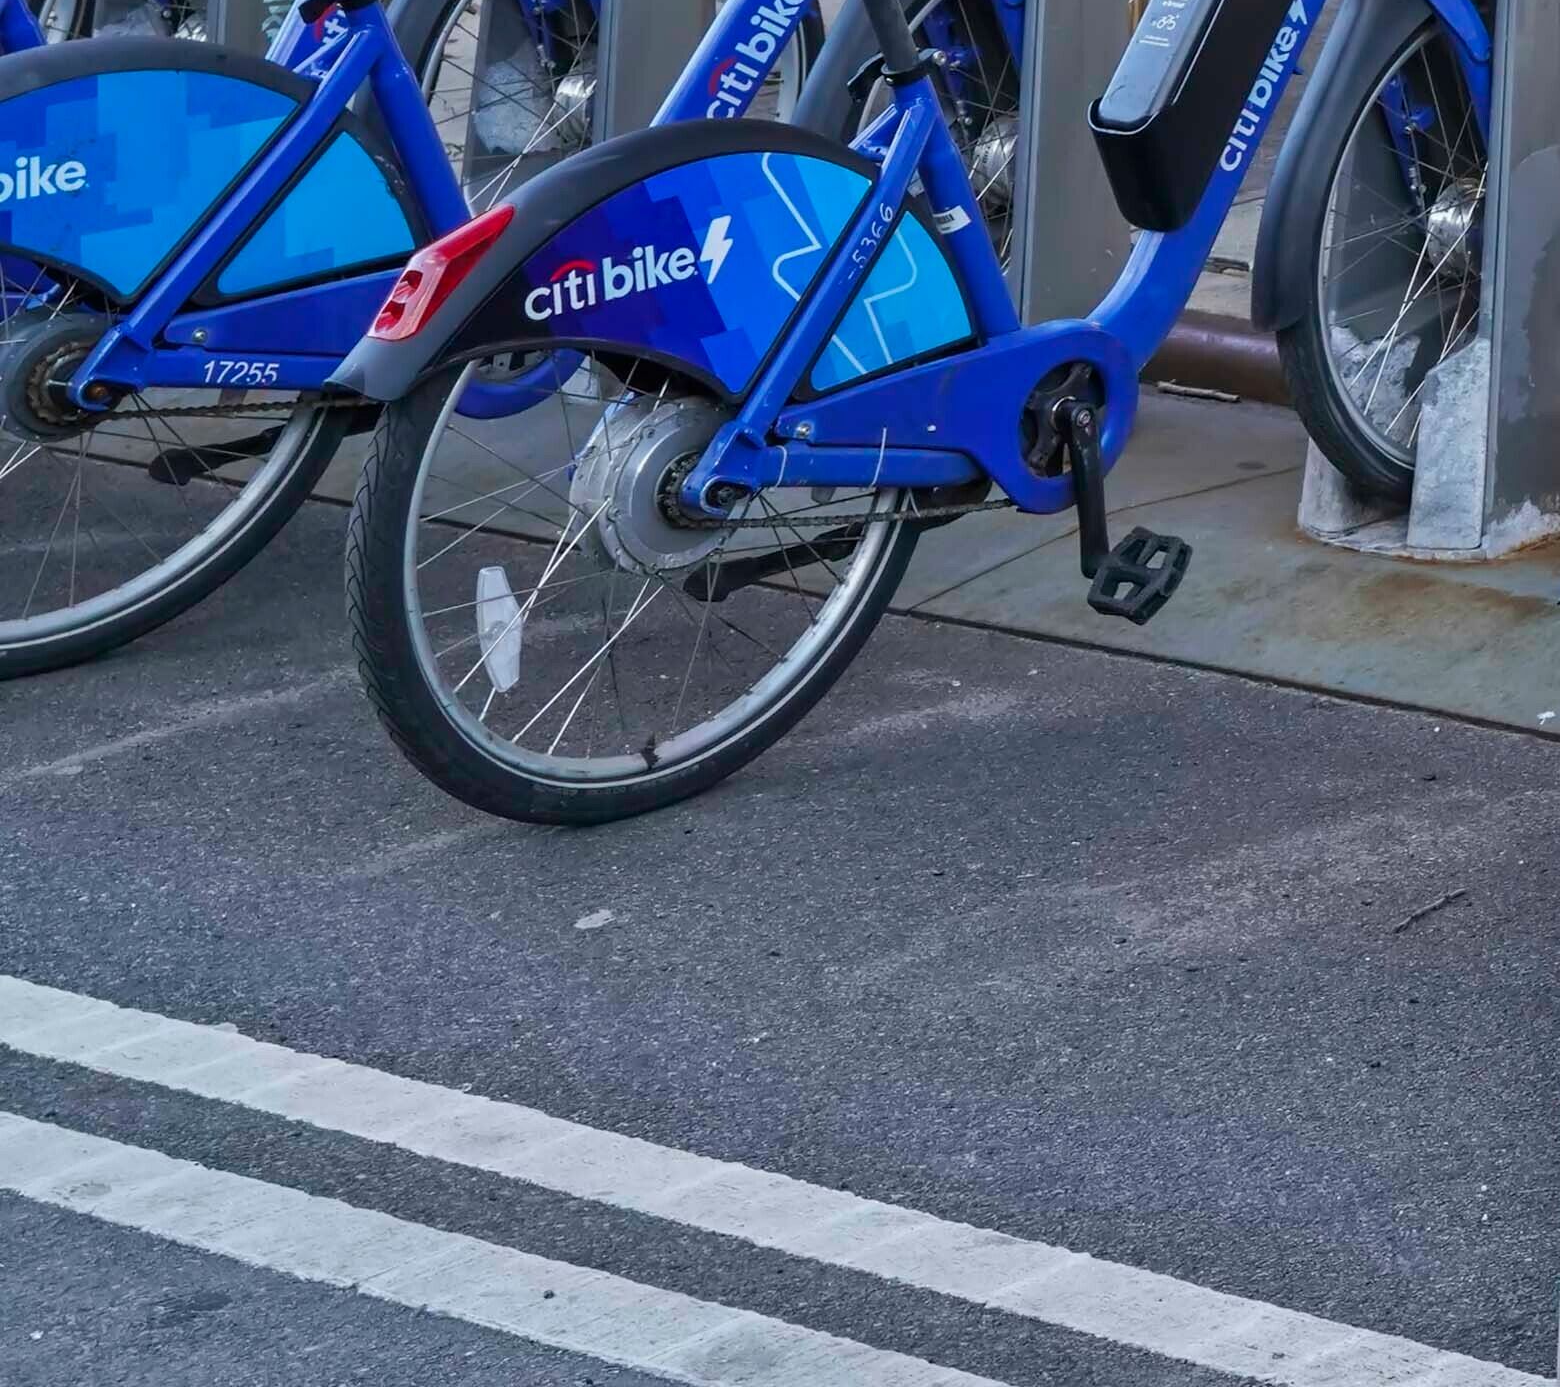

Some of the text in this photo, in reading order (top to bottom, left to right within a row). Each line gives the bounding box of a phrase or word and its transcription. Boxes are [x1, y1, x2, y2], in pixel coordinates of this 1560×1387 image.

[1219, 26, 1301, 172] citi bike
[524, 242, 696, 324] citi bike
[202, 360, 281, 387] 17255
